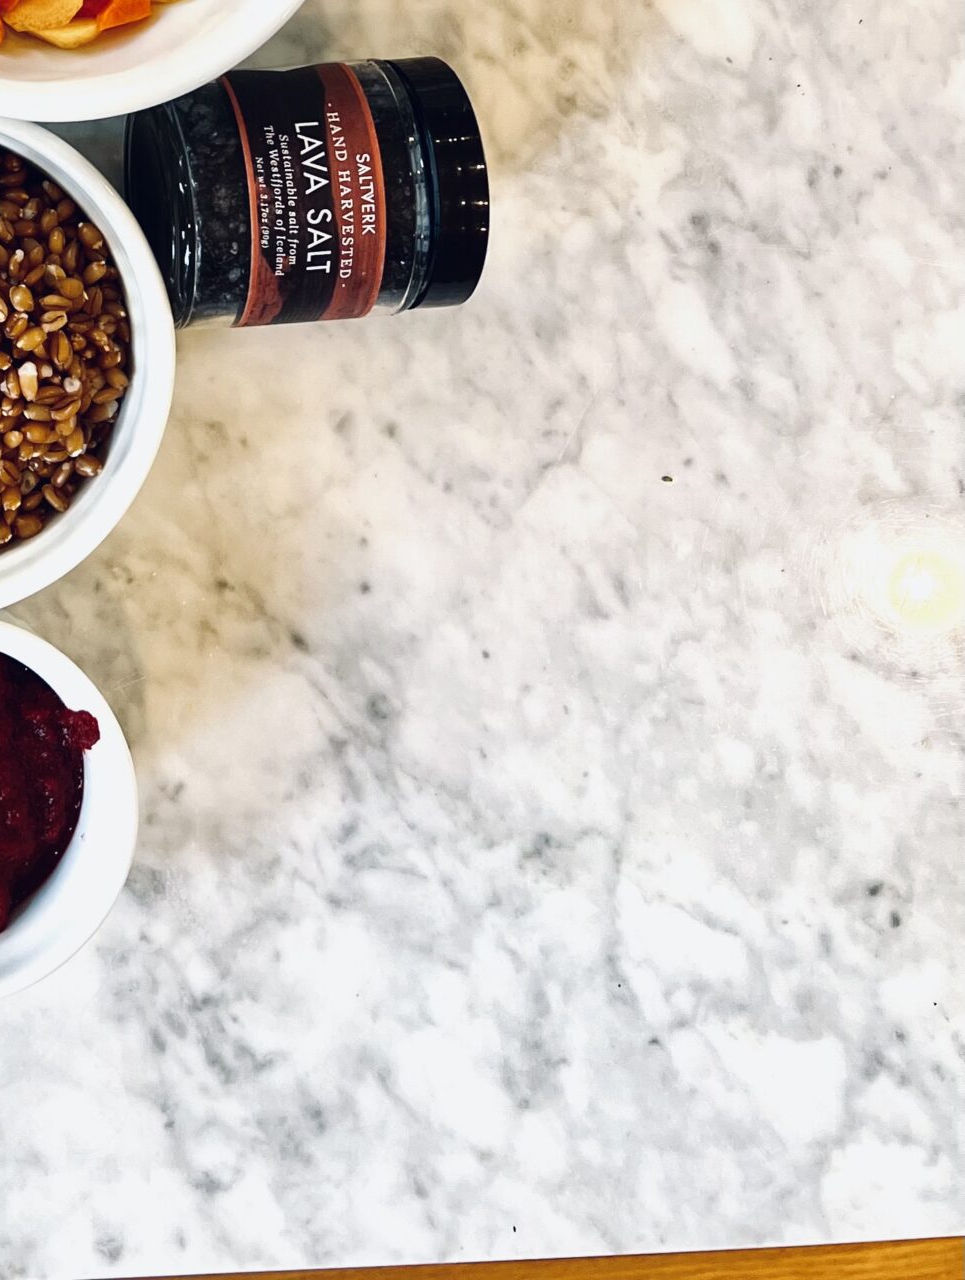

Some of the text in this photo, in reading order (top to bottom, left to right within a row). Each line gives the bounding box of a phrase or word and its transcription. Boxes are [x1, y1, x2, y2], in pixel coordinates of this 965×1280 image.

[255, 157, 264, 173] Net
[261, 226, 270, 249] (90g)
[263, 125, 286, 276] The Westfjords of Iceland
[279, 134, 299, 265] Sustainable salt from
[294, 122, 332, 274] LAVA SALT
[327, 112, 354, 279] HAND HARVESTED
[356, 153, 375, 235] SALTVERK
